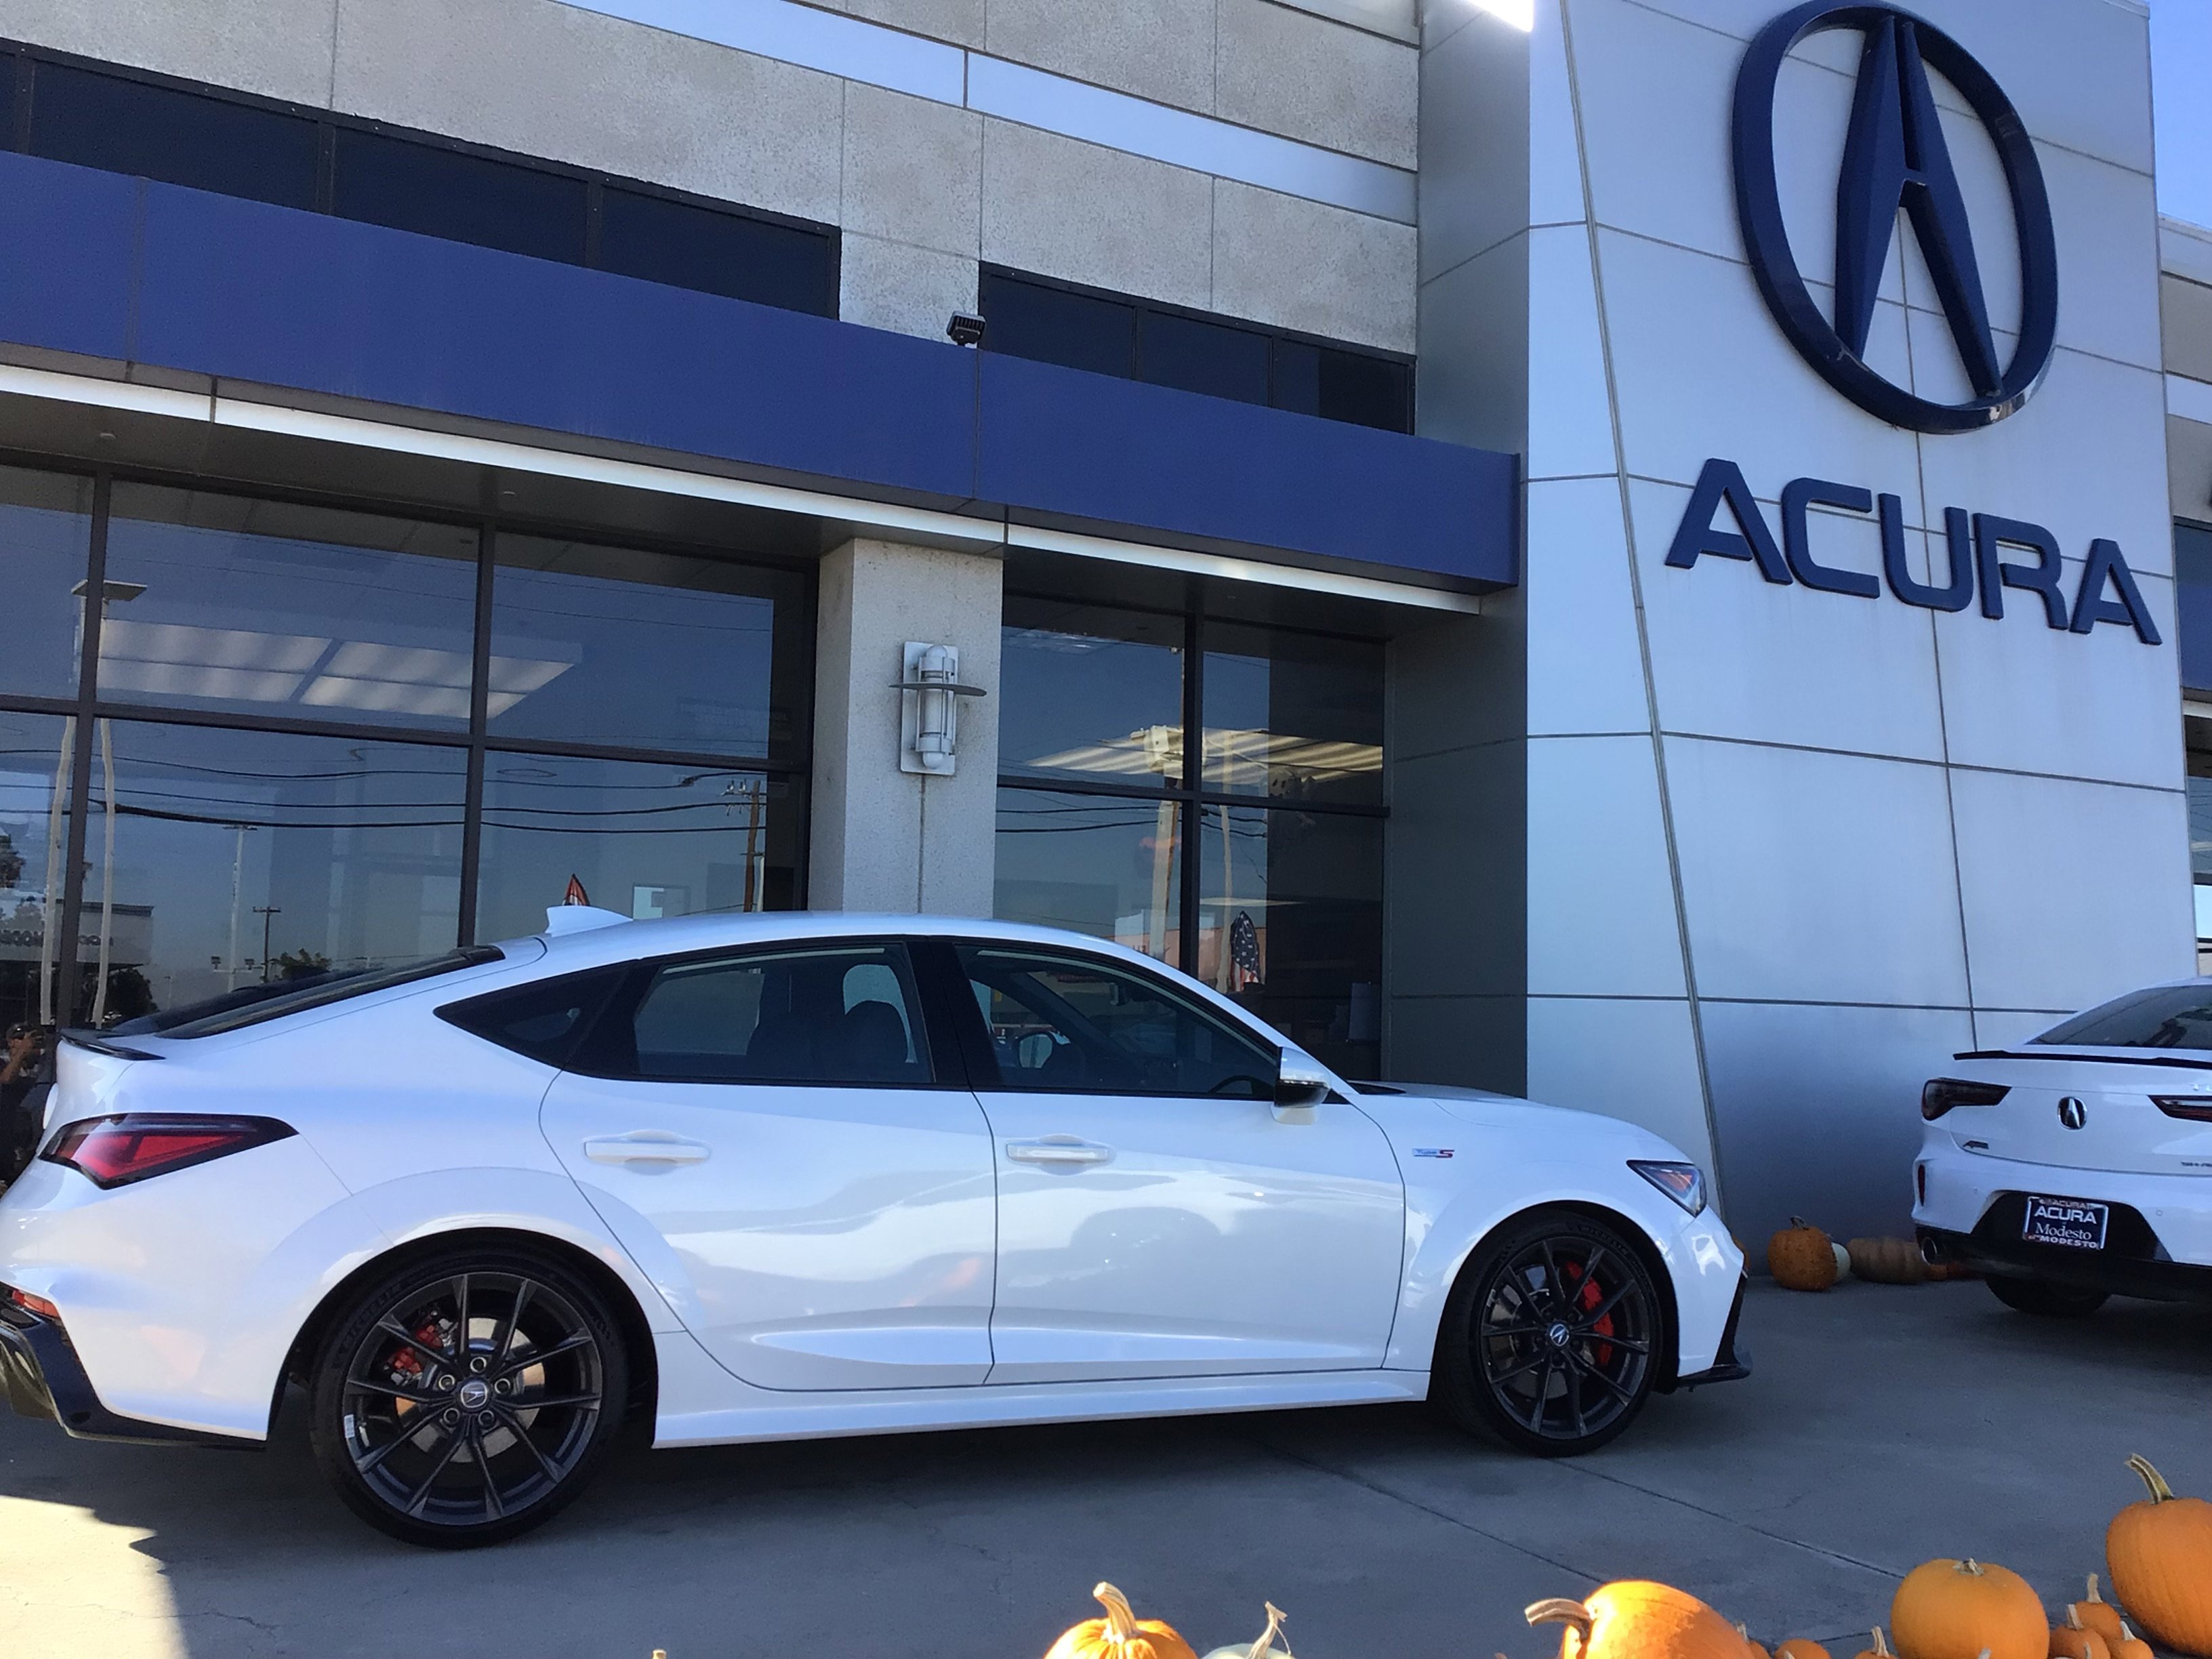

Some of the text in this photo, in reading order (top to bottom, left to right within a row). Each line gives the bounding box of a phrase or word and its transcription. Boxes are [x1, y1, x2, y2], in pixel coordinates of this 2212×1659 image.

[1664, 457, 2163, 645] ACURA
[2034, 1206, 2097, 1225] ACURA
[2035, 1222, 2092, 1240] Modesto
[2039, 1235, 2097, 1249] MODESTO
